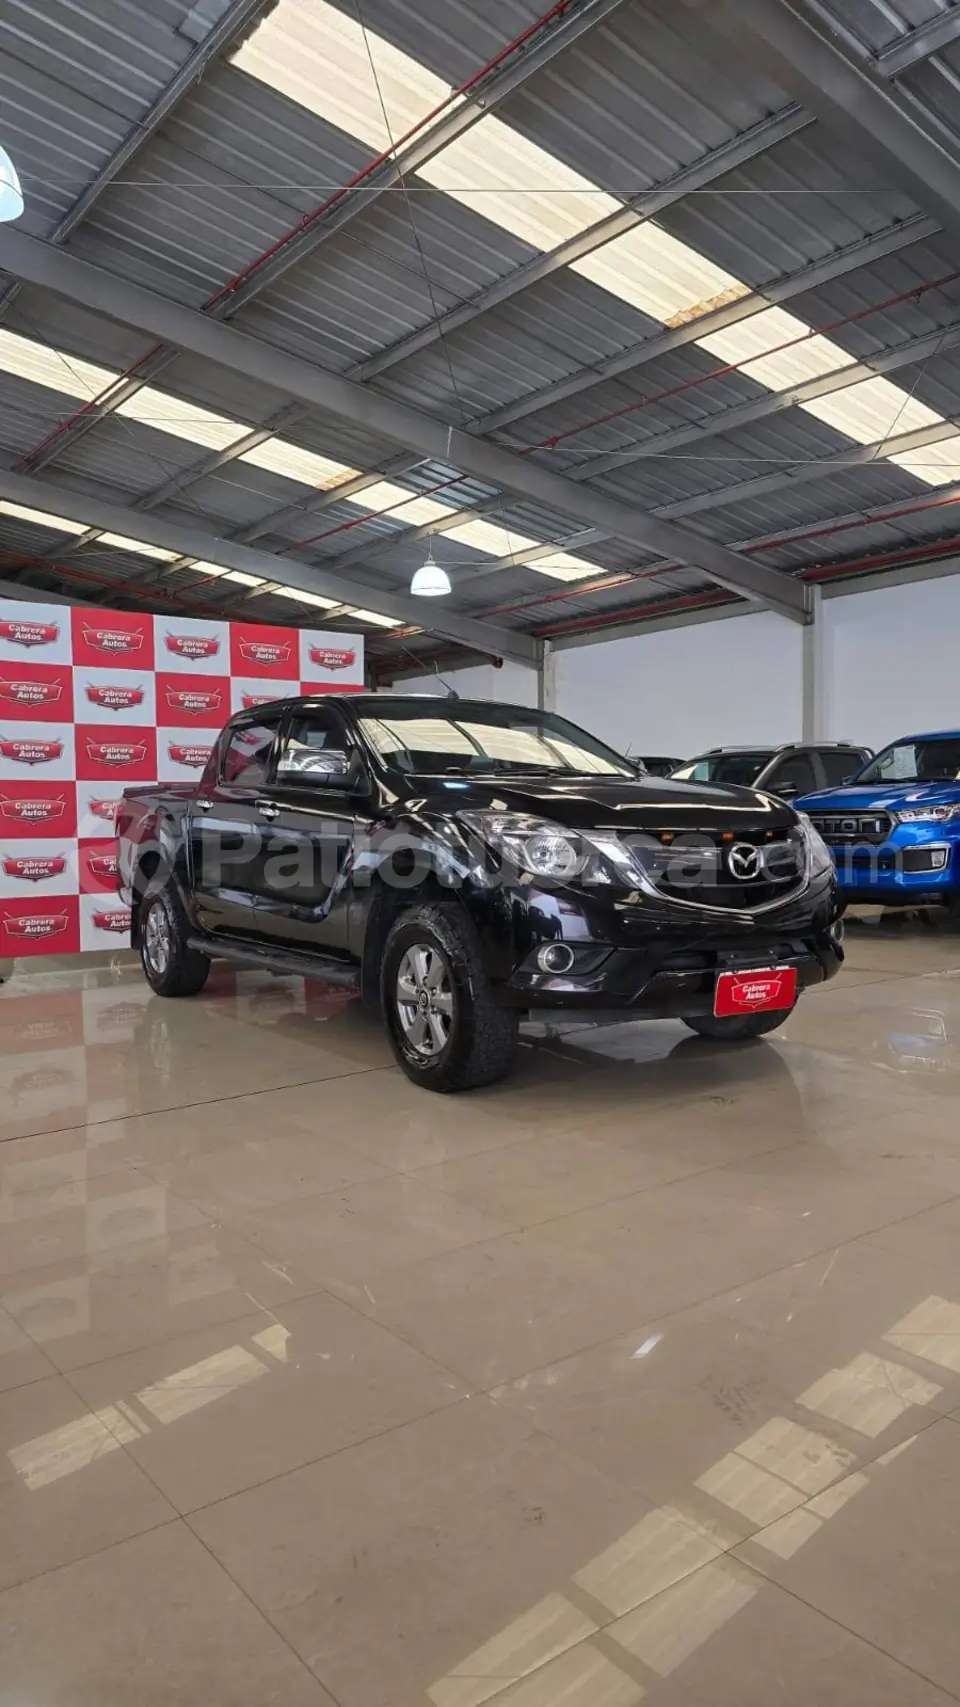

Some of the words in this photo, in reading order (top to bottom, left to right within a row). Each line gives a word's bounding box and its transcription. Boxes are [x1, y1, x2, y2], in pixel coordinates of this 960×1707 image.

[9, 623, 46, 635] Cabrera
[14, 632, 42, 641] Autos
[96, 632, 131, 642] Cabrera
[102, 640, 127, 648] Autos
[177, 639, 208, 648] Cabrera
[182, 646, 205, 654] Autos
[251, 645, 280, 654] Cabrera
[256, 652, 277, 660] Autos
[319, 650, 346, 659] Cabrera
[324, 657, 343, 665] Autos
[10, 684, 48, 693] Cabrera
[17, 691, 44, 700] Autos
[98, 689, 132, 698] Cabrera
[104, 696, 128, 704] Autos
[179, 694, 210, 702] Cabrera
[13, 743, 50, 752] Cabrera
[100, 746, 134, 754] Cabrera
[19, 750, 46, 758] Autos
[106, 752, 130, 760] Autos
[185, 754, 206, 762] Autos
[15, 802, 51, 810] Cabrera
[25, 925, 51, 933] Autos
[742, 984, 770, 993] Cabrera
[745, 992, 766, 1000] Autos
